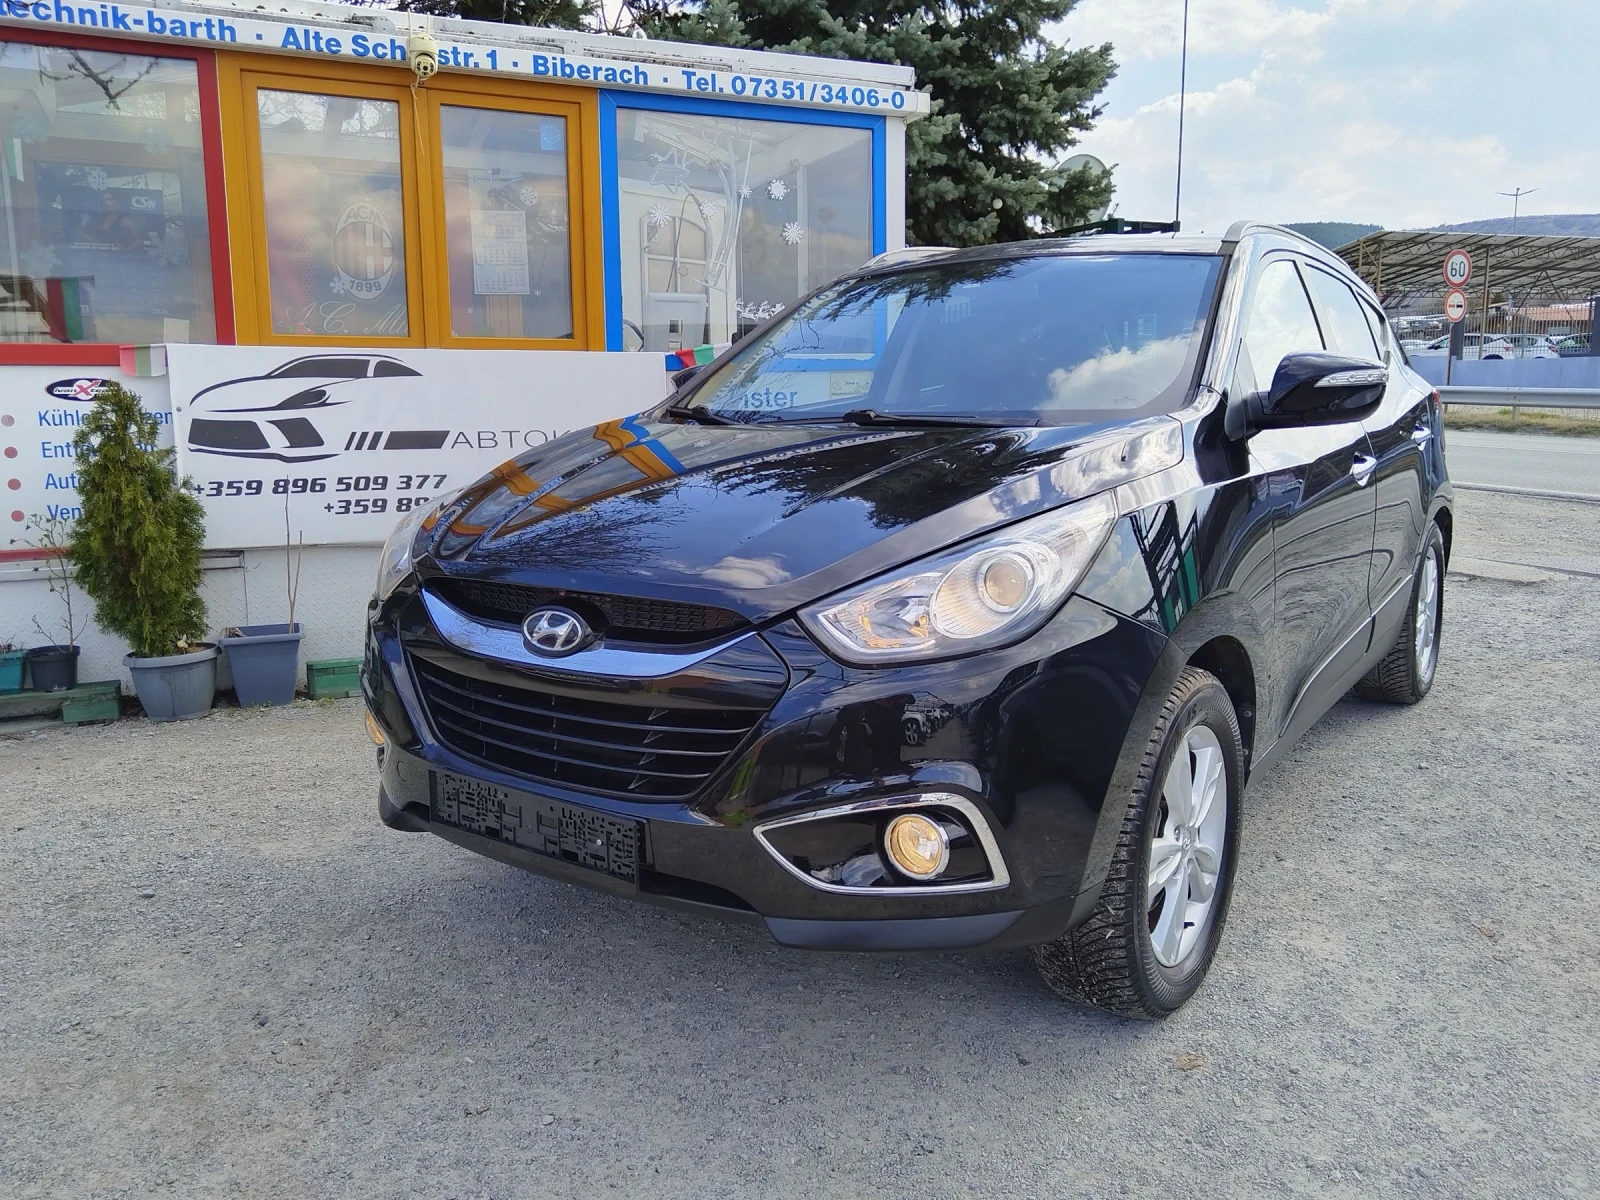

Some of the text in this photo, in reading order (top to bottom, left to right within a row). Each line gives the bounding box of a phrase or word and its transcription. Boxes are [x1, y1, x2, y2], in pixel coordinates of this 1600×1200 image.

[281, 27, 342, 54] Alte
[352, 35, 479, 68] Schstr.
[533, 55, 648, 85] Biberach
[682, 70, 724, 93] Tel.
[731, 75, 905, 109] 07351/3406-0
[343, 206, 383, 226] ACM
[1450, 261, 1466, 277] 60
[349, 280, 382, 293] 1899
[193, 474, 447, 497] +359 896 509 377
[323, 497, 430, 514] +359 89
